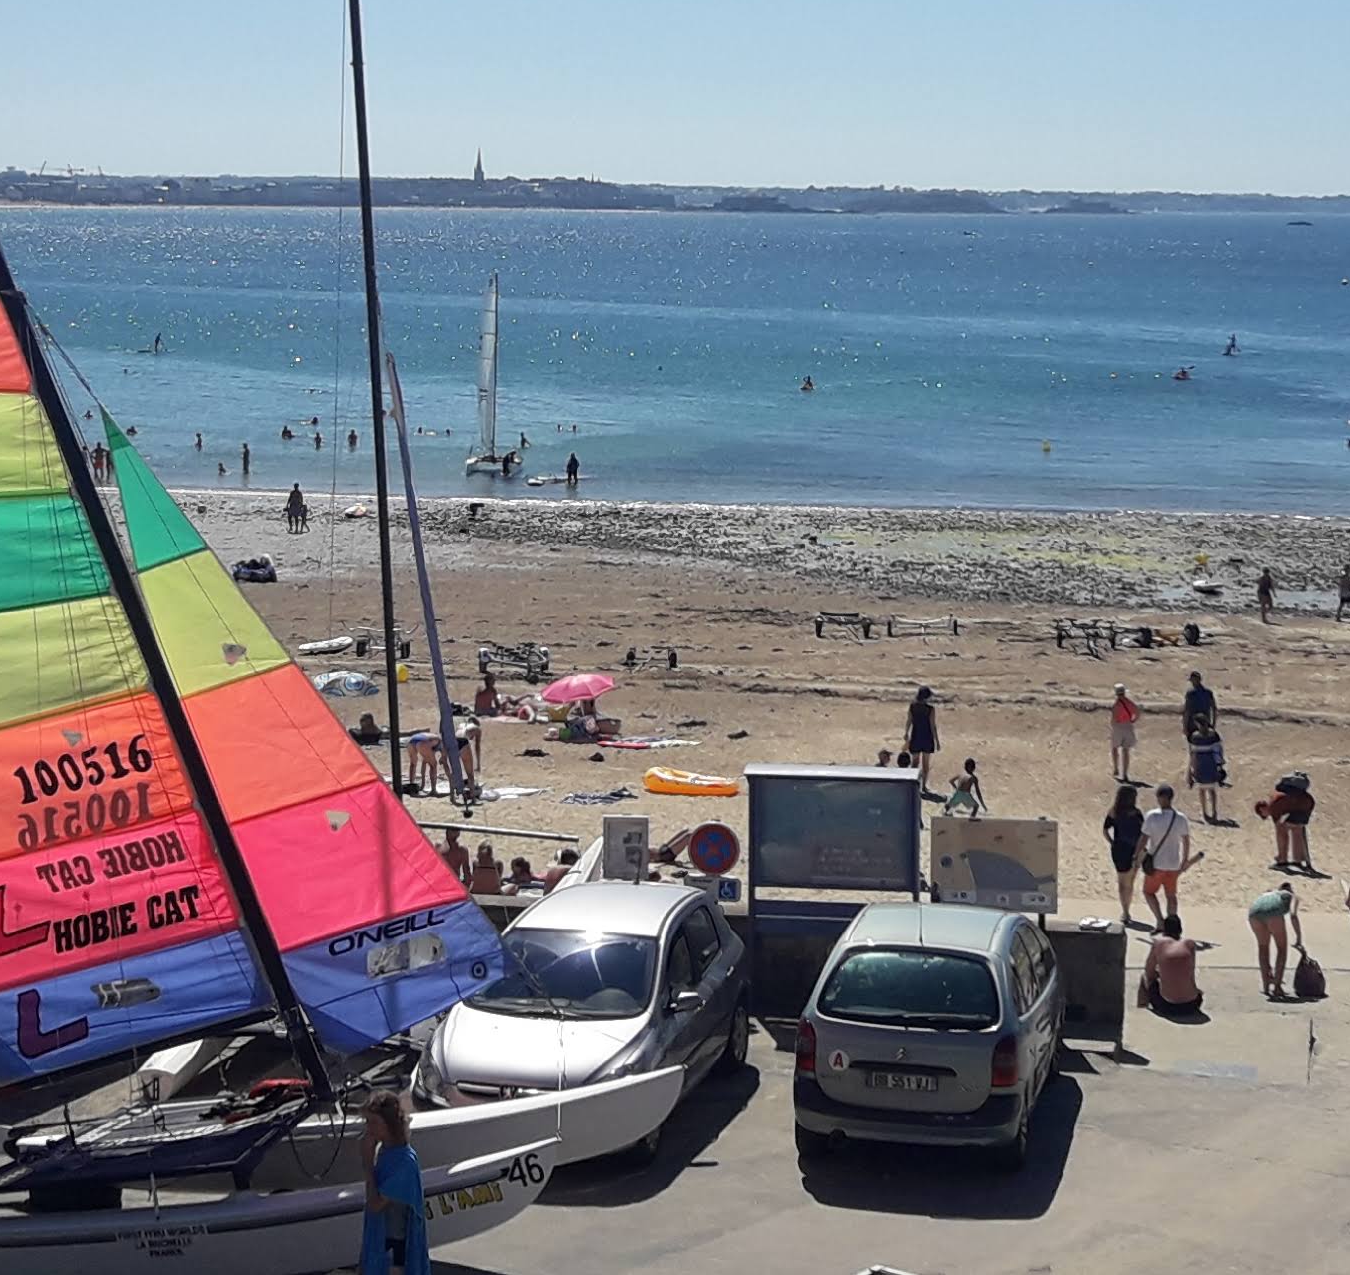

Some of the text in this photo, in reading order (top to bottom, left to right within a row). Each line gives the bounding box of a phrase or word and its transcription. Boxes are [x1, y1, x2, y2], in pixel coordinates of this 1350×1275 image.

[13, 734, 153, 805] 100516
[52, 885, 200, 954] HOBIE CAT
[833, 1052, 844, 1069] A
[508, 1153, 545, 1187] 46
